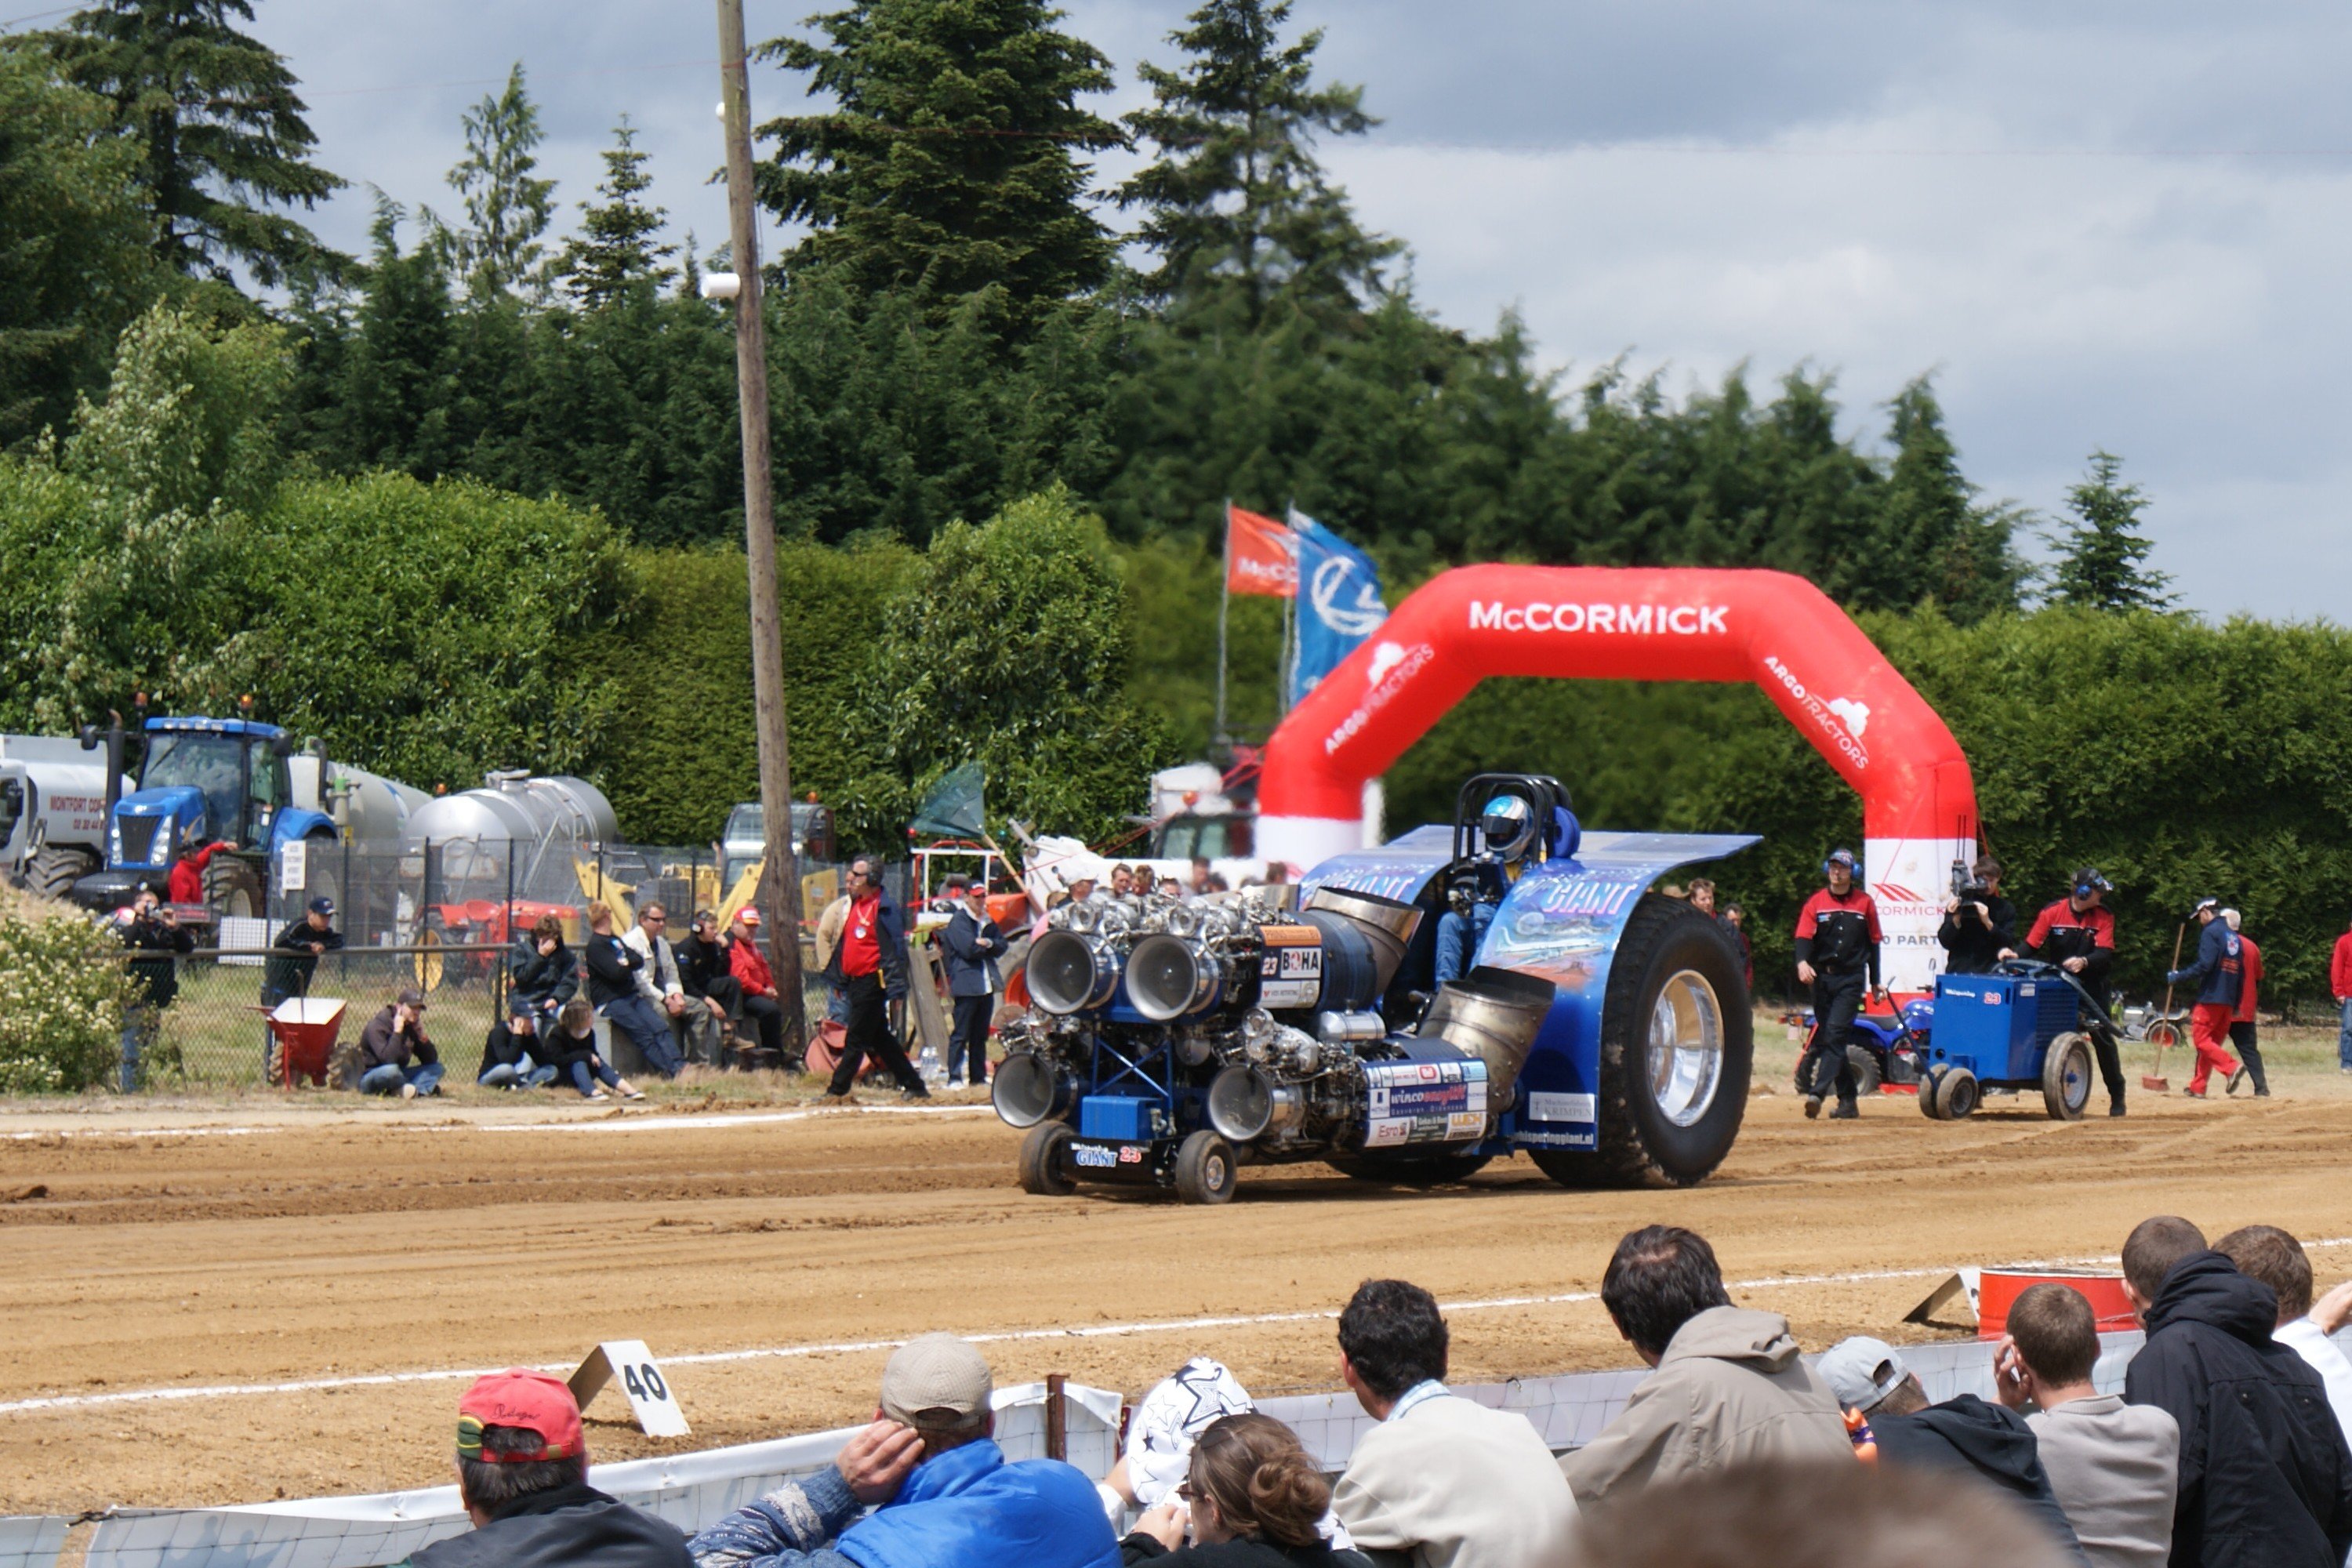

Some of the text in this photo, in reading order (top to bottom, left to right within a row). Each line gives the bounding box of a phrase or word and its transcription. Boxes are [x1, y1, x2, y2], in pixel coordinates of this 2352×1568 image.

[1468, 601, 1730, 634] McCORMICK
[1764, 656, 1869, 769] ARGOTRACTORS
[50, 796, 86, 812] MONTFORT
[1542, 881, 1639, 915] GIANT
[1876, 906, 1946, 916] CORMICK
[1897, 935, 1940, 945] PART
[1261, 951, 1319, 975] 23 BOHA
[1984, 992, 2002, 1005] 23
[1076, 1146, 1142, 1168] GIANT 23
[623, 1363, 668, 1403] 40
